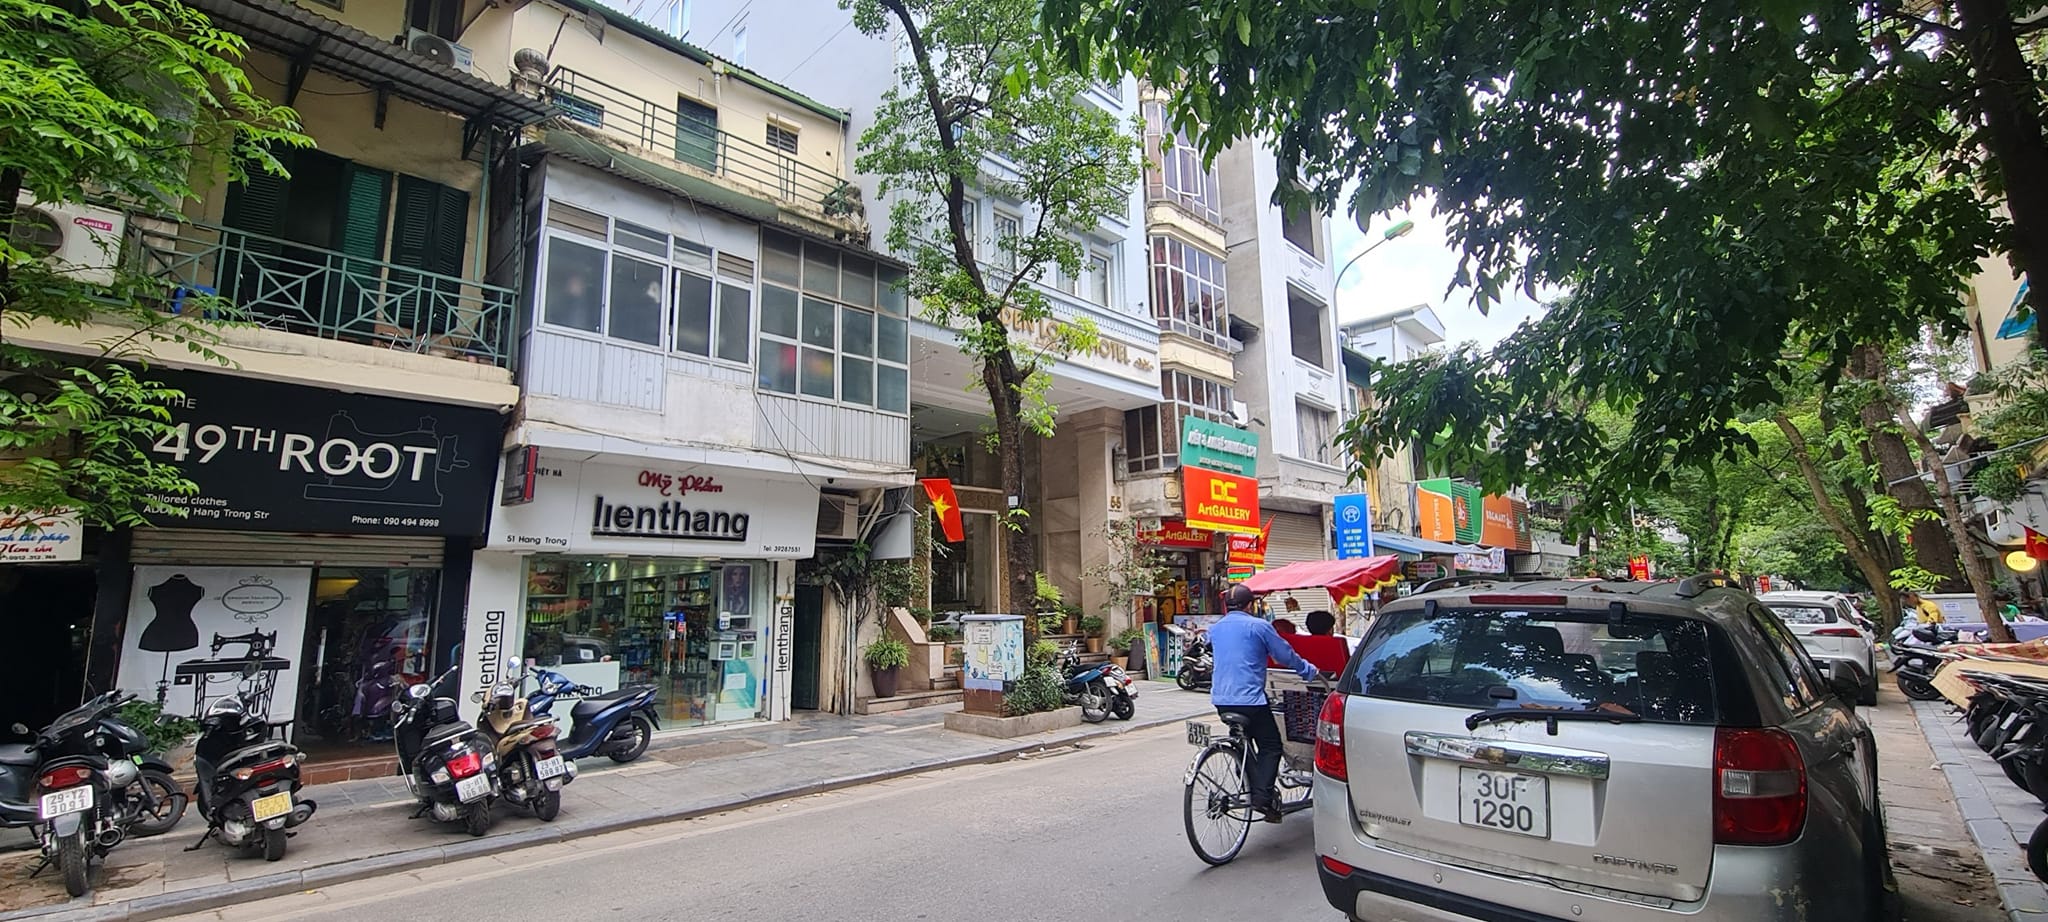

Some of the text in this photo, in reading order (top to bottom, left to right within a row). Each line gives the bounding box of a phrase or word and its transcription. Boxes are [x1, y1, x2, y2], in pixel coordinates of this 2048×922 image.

[279, 433, 437, 481] ROOT
[145, 493, 227, 507] Tailored clothes
[1110, 495, 1122, 509] 55
[193, 508, 220, 519] Hang
[223, 509, 251, 521] Trong
[253, 511, 270, 520] Str
[1198, 502, 1251, 521] ArtGALLERY
[351, 515, 440, 528] Phone: 090 494 8998
[506, 534, 567, 547] 51 Hang Trong
[1477, 772, 1526, 802] 30F
[50, 798, 85, 815] 3091
[1473, 798, 1532, 832] 1290
